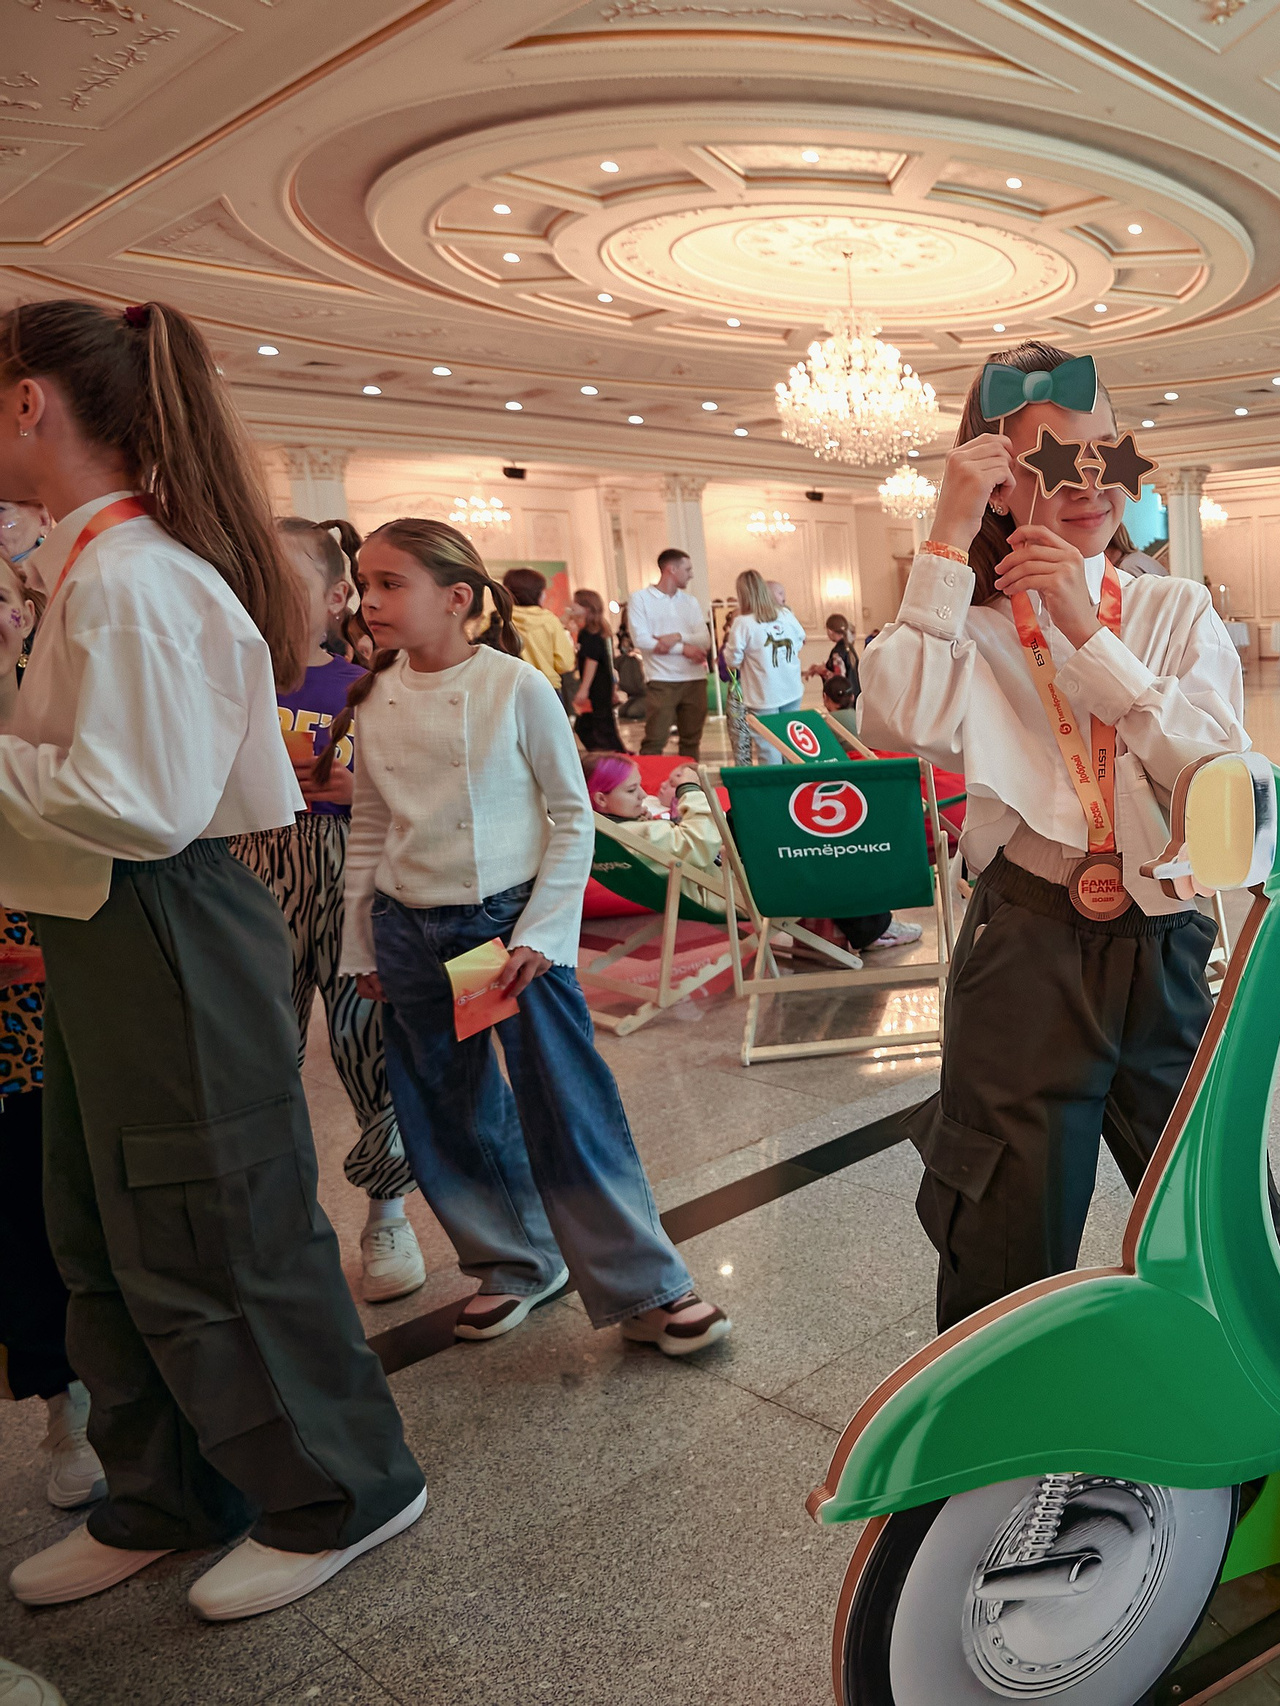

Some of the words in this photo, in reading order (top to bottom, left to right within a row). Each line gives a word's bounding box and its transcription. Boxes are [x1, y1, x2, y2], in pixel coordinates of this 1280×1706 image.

[1030, 637, 1046, 667] ESTEL
[1097, 748, 1107, 781] ESTEL
[777, 842, 892, 859] Пятёрочка
[1081, 878, 1117, 887] FAME
[1081, 885, 1125, 894] FLAME
